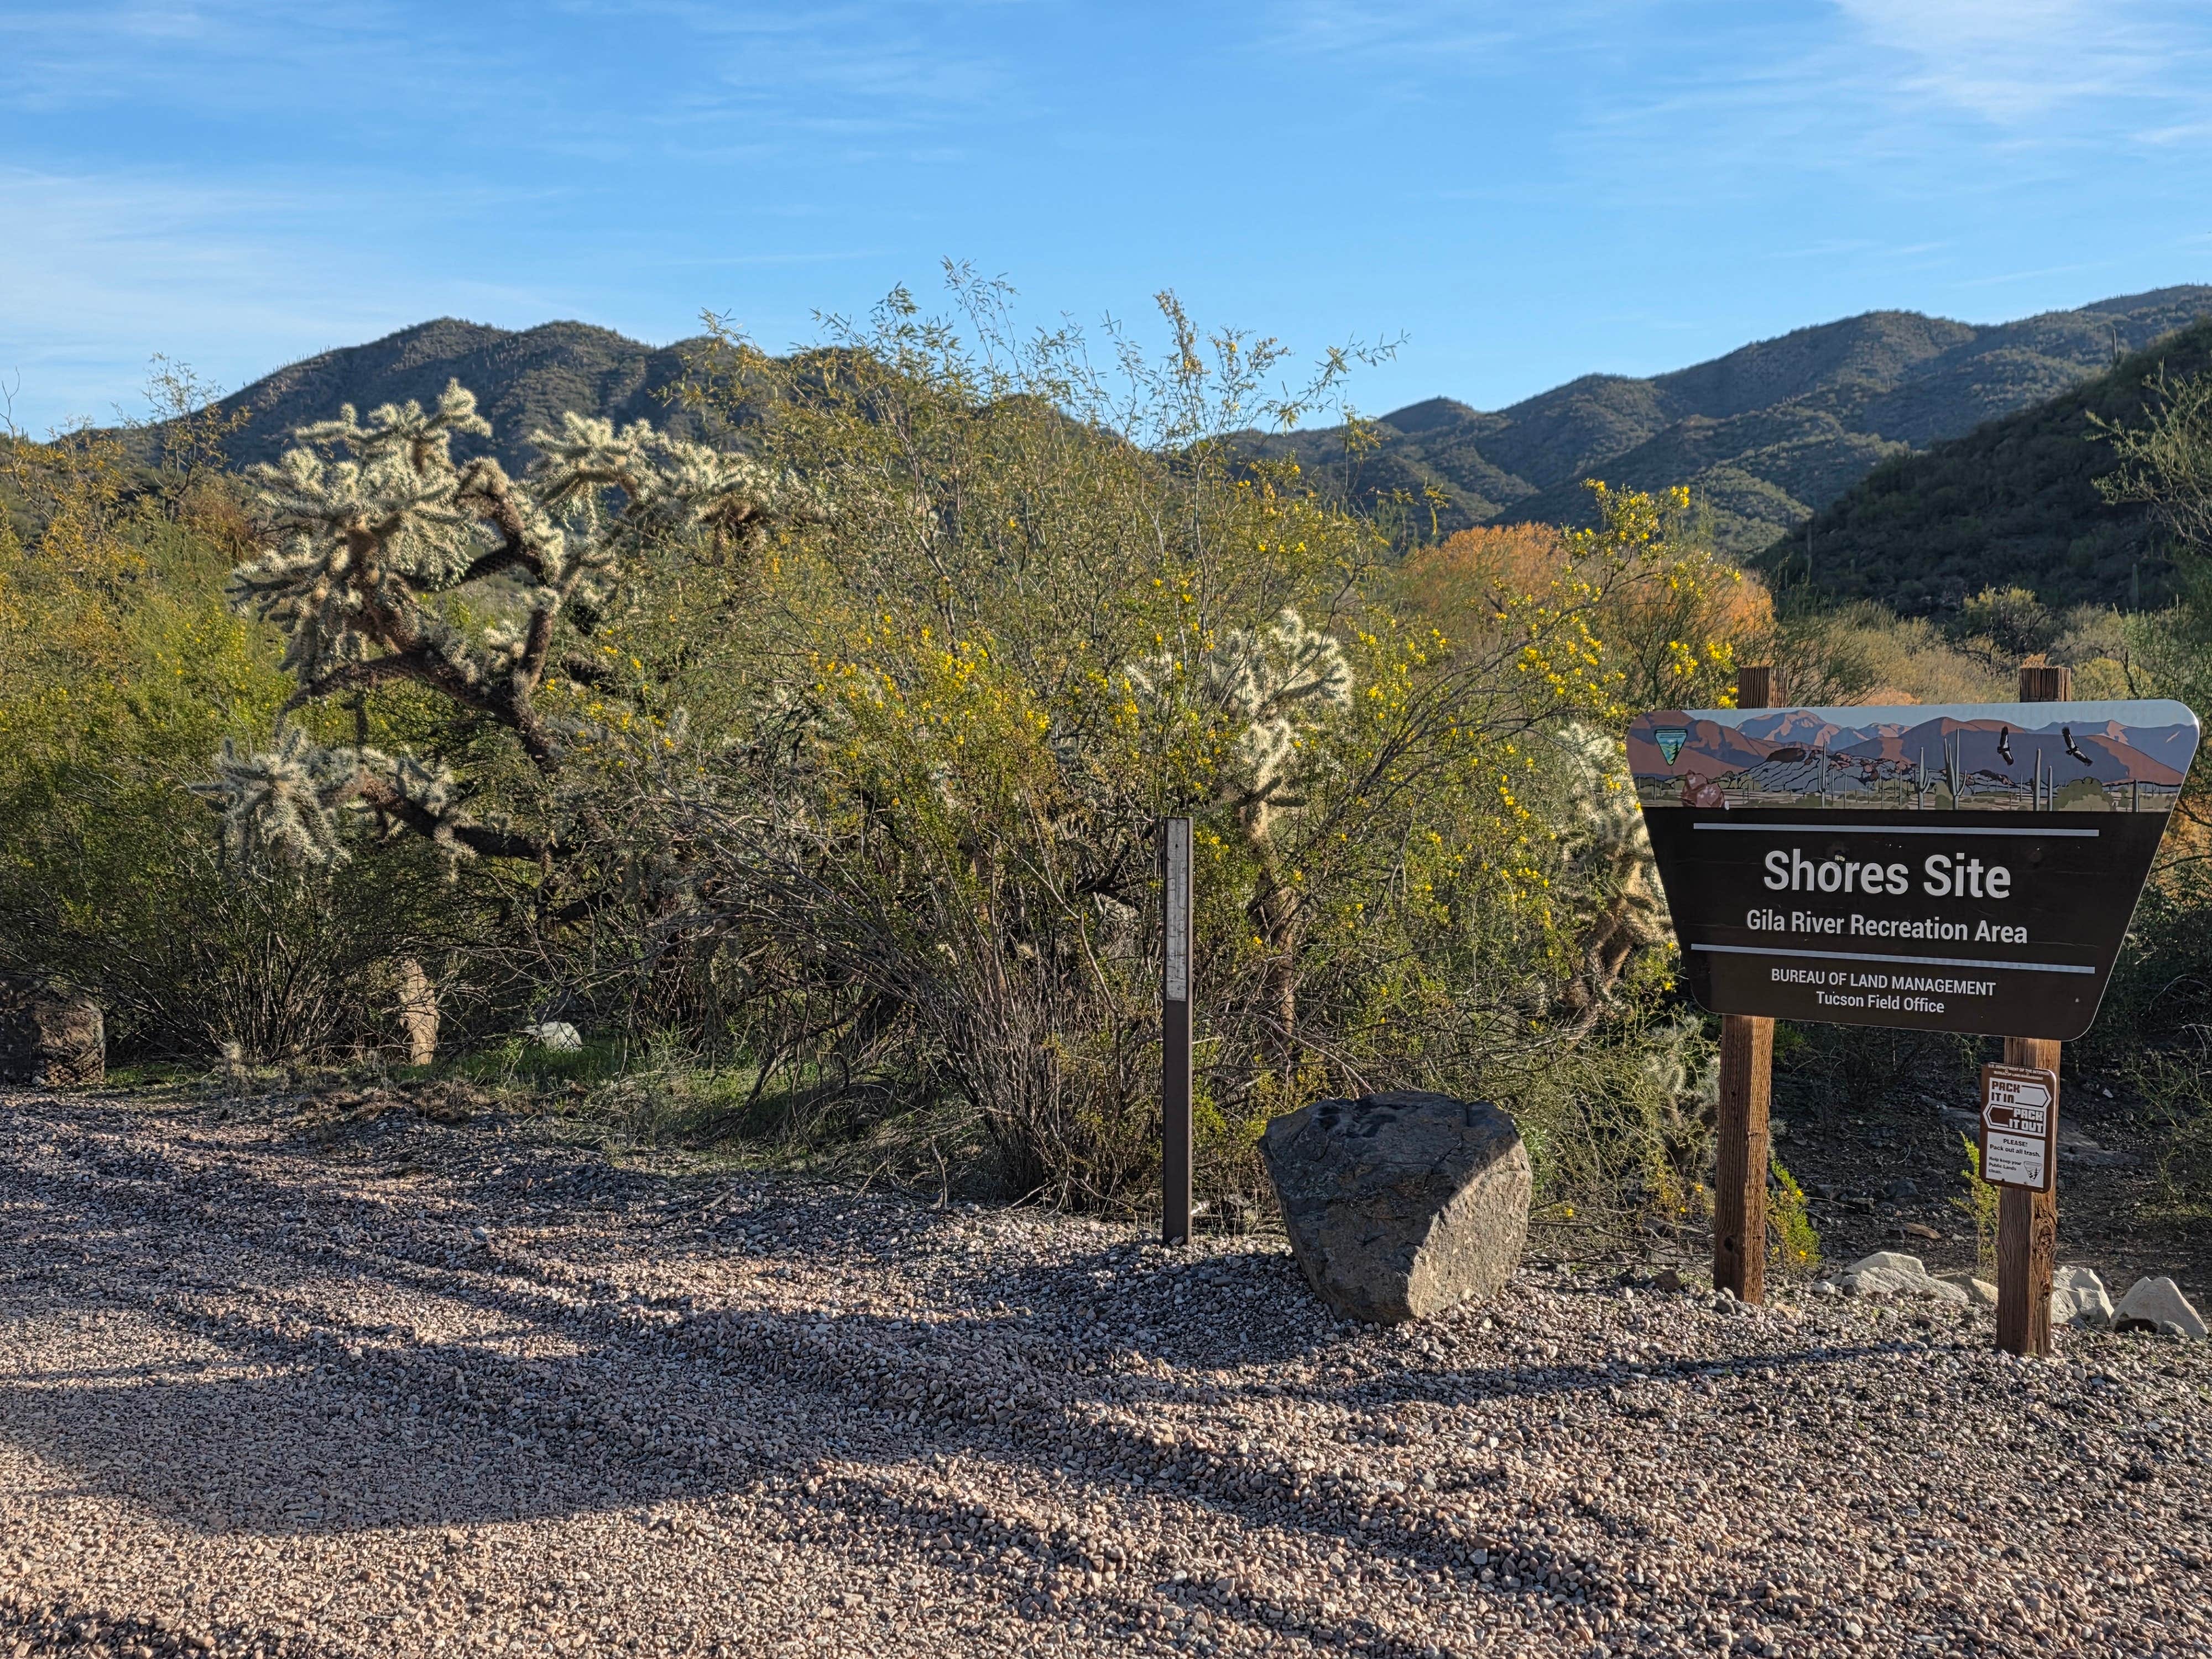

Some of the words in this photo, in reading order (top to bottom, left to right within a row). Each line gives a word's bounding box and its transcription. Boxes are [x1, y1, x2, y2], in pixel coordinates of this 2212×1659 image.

[1764, 848, 1908, 895] Shores
[1923, 852, 2011, 899] Site
[1747, 909, 1785, 931] Gila
[1792, 911, 1844, 934] River
[1851, 914, 1968, 941] Recreation
[1974, 920, 2027, 943] Area
[1771, 968, 1825, 985] BUREAU
[1829, 972, 1847, 985] OF
[1850, 973, 1888, 989] LAND
[1892, 975, 1996, 996] MANAGEMENT
[1816, 991, 1864, 1007] Tucson
[1868, 994, 1900, 1010] Field
[1903, 997, 1944, 1013] Office
[1991, 1081, 2021, 1093] PACK
[1991, 1092, 2002, 1102] IT
[2013, 1108, 2044, 1122] PACK
[2008, 1119, 2020, 1129] IT
[2021, 1121, 2043, 1133] OUT
[2003, 1138, 2028, 1147] PLEASE!
